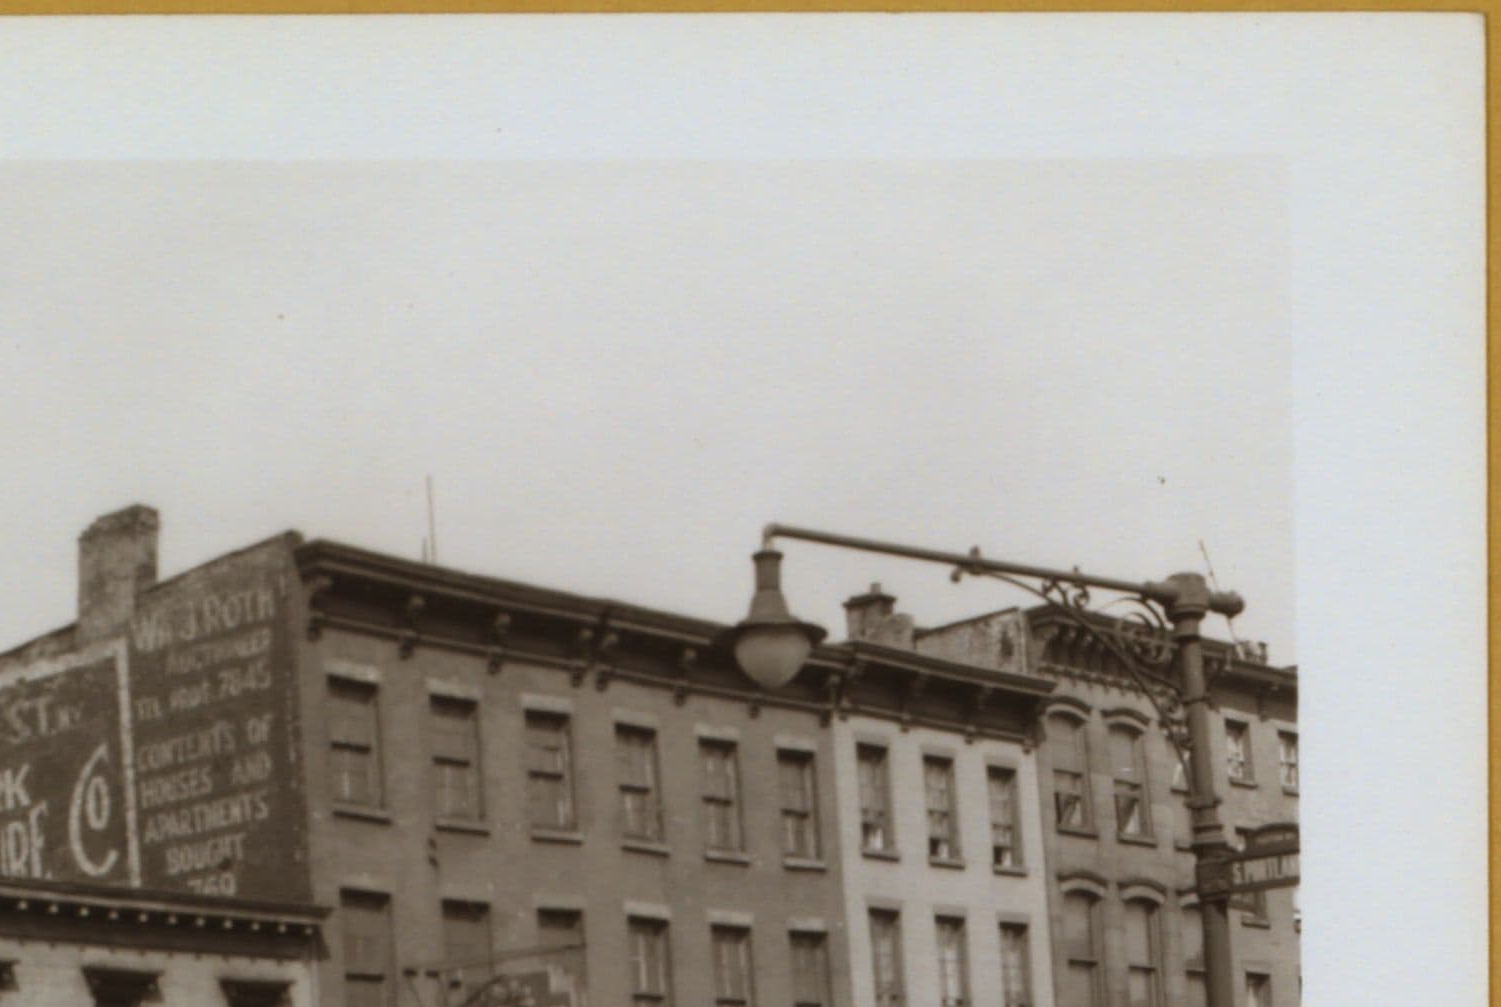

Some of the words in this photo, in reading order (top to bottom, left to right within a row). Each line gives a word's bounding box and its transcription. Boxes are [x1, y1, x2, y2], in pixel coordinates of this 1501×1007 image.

[137, 720, 236, 772] CONTENTS
[246, 713, 273, 744] OF
[140, 766, 212, 809] HOUSES
[232, 751, 273, 785] AND
[144, 789, 270, 844] APARTMENTS
[165, 832, 247, 876] BOUGHT
